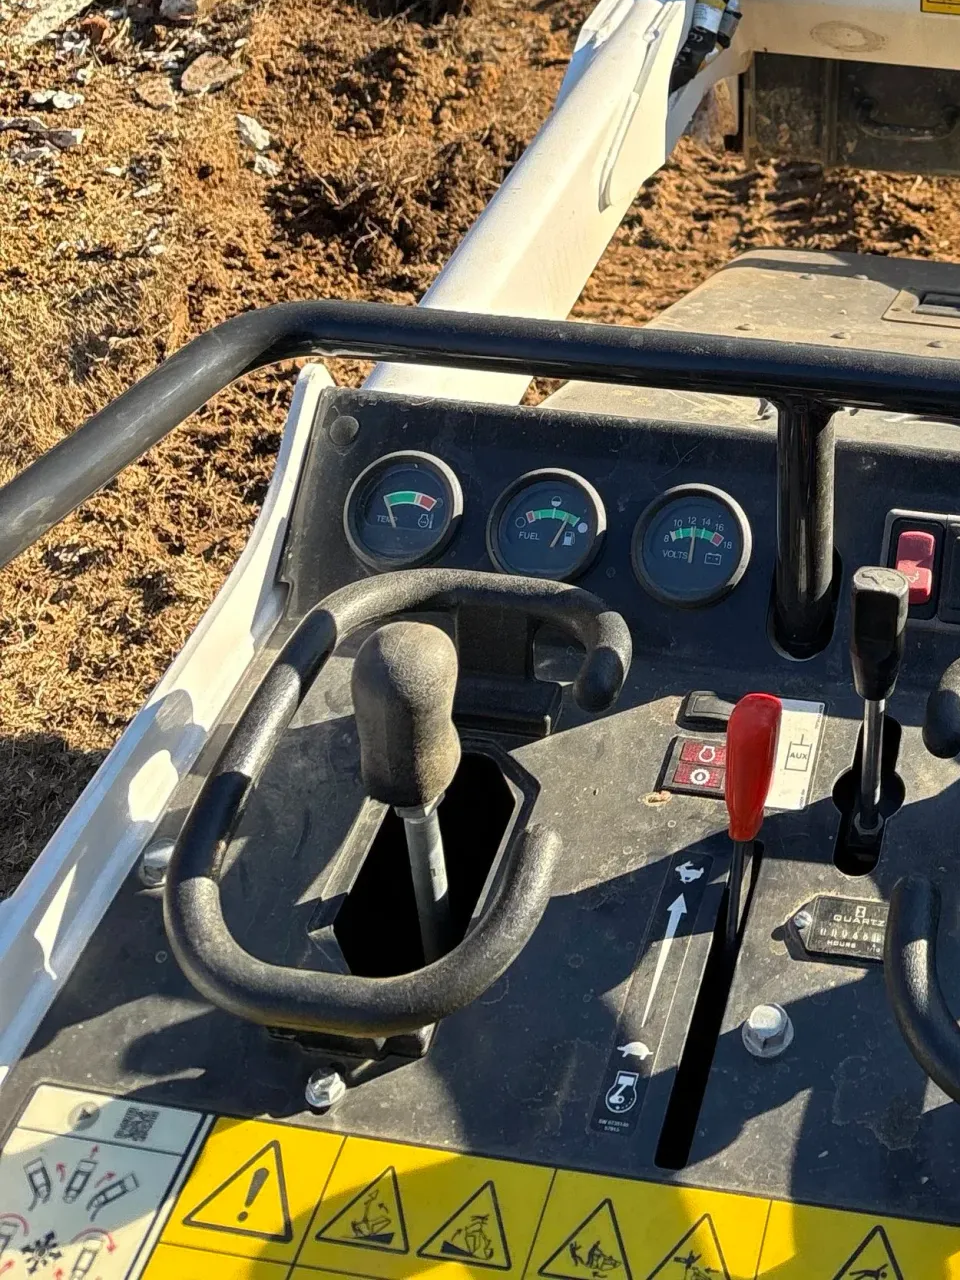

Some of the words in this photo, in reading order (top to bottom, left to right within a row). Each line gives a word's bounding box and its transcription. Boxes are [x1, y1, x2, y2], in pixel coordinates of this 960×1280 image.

[674, 519, 683, 527] 10
[687, 516, 697, 525] 12
[702, 518, 711, 526] 14
[715, 523, 724, 532] 16
[518, 531, 540, 540] FUEL
[663, 534, 670, 543] 8
[723, 541, 733, 550] 18
[662, 549, 688, 560] VOLTS
[789, 751, 808, 760] AUX
[833, 914, 886, 927] QUARTZ
[826, 939, 857, 949] HOURS
